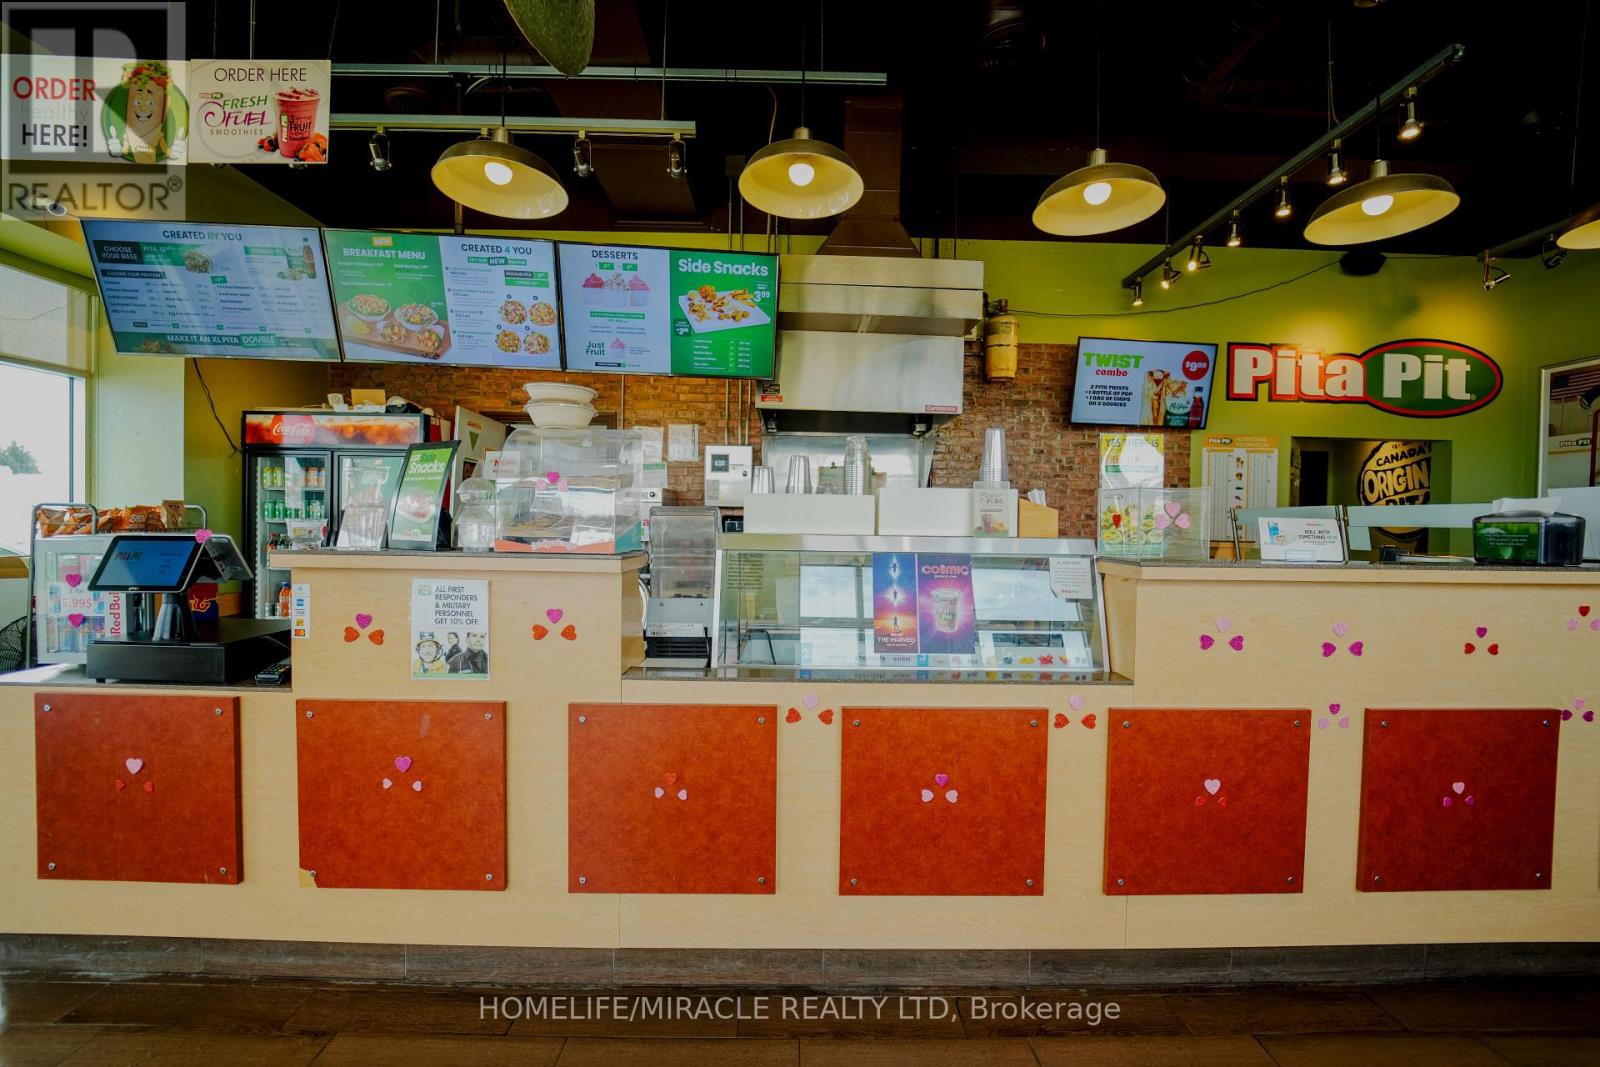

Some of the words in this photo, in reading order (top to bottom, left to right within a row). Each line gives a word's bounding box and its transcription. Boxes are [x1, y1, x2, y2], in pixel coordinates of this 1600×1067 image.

[213, 68, 264, 81] ORDER
[270, 68, 307, 81] HERE
[13, 76, 97, 101] ORDER
[222, 95, 268, 110] FRESH
[22, 123, 88, 148] HERE!
[209, 128, 264, 136] SMOOTHIES
[162, 229, 206, 241] CREATED
[207, 231, 220, 241] BY
[220, 231, 243, 242] YOU
[103, 245, 134, 253] CHOOSE
[342, 247, 397, 259] BREAKFAST
[398, 250, 426, 260] MENU
[461, 243, 503, 254] CREATED
[512, 246, 533, 255] YOU
[591, 249, 639, 260] DESSERTS
[678, 257, 712, 273] Side
[713, 260, 769, 277] Snacks
[242, 335, 275, 344] DOUBLE
[586, 341, 606, 349] Just
[585, 348, 606, 356] Fruit
[1082, 351, 1145, 369] TWIST
[1095, 368, 1128, 377] combo
[1232, 347, 1366, 398] Pita
[1105, 438, 1121, 448] YES
[408, 460, 446, 474] Snacks
[434, 585, 447, 593] ALL
[434, 593, 478, 601] RESPONDERS
